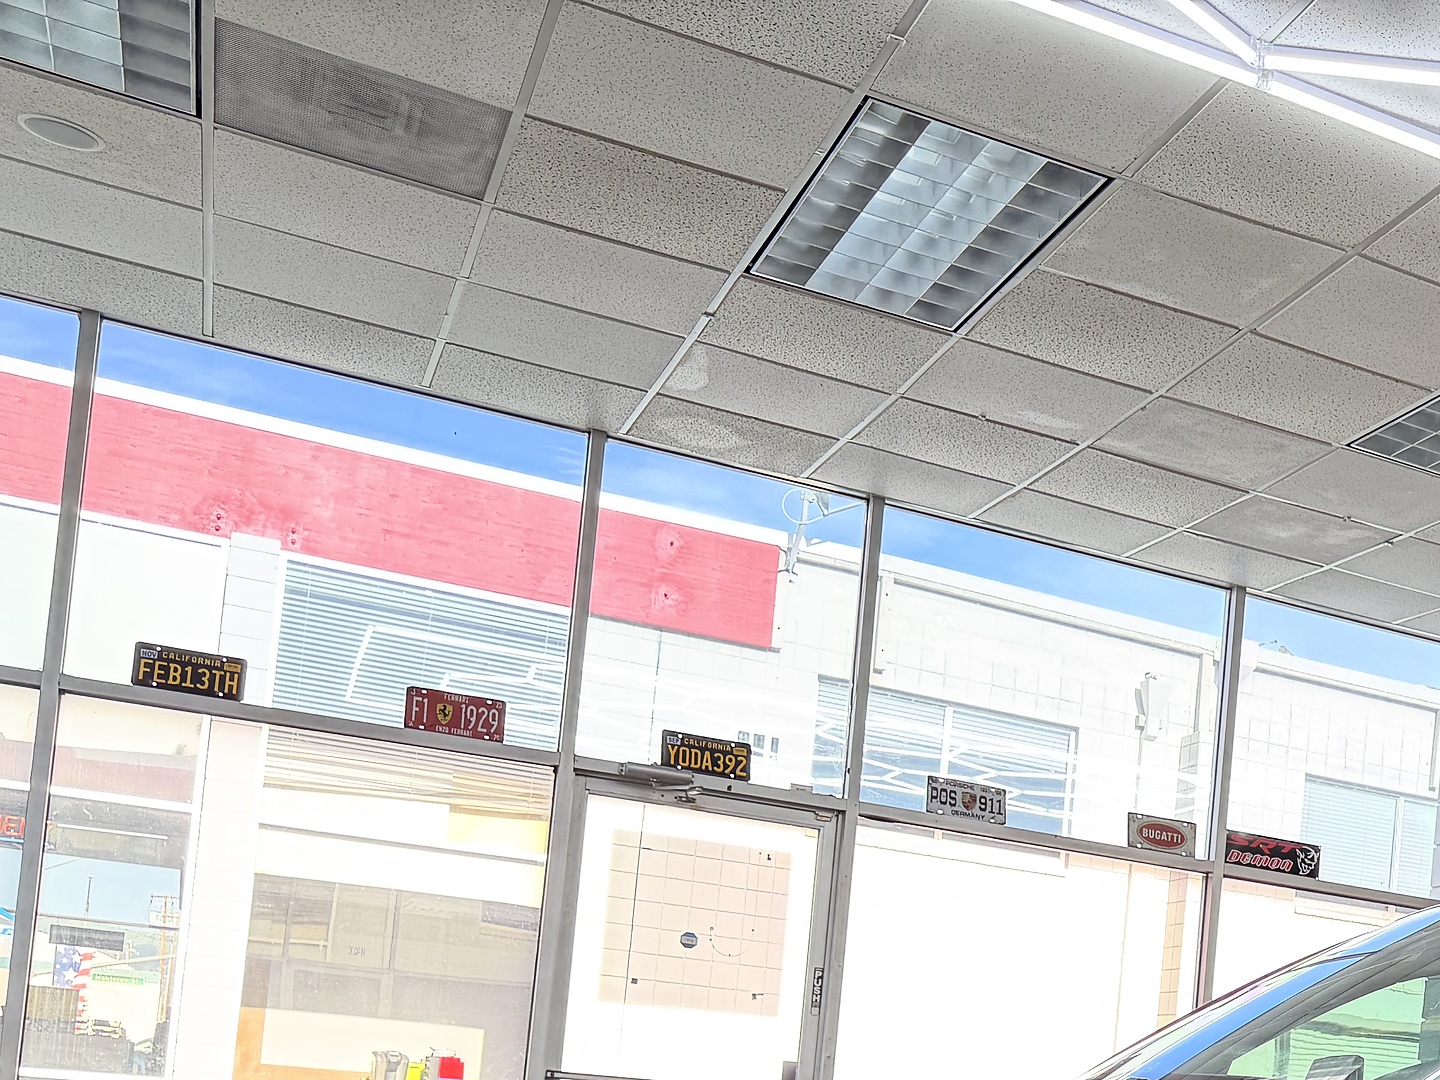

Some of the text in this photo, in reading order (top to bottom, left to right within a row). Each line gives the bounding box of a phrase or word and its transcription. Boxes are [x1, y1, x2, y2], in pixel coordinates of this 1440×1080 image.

[141, 650, 158, 659] NOV
[162, 651, 221, 668] CALIFORNIA
[138, 658, 239, 695] FEB13TH
[443, 693, 469, 704] FERRARI
[411, 696, 499, 733] F1 1929
[435, 725, 473, 737] ENZO FERRARI
[683, 738, 732, 752] CALIFORNIA
[667, 744, 747, 777] YODA392
[945, 780, 976, 791] PORSCHE
[930, 786, 1004, 815] POS 911
[950, 809, 986, 821] GERMANY
[1142, 827, 1181, 843] BUGATTI
[1226, 834, 1303, 855] SRT
[813, 970, 823, 1003] PUSH
